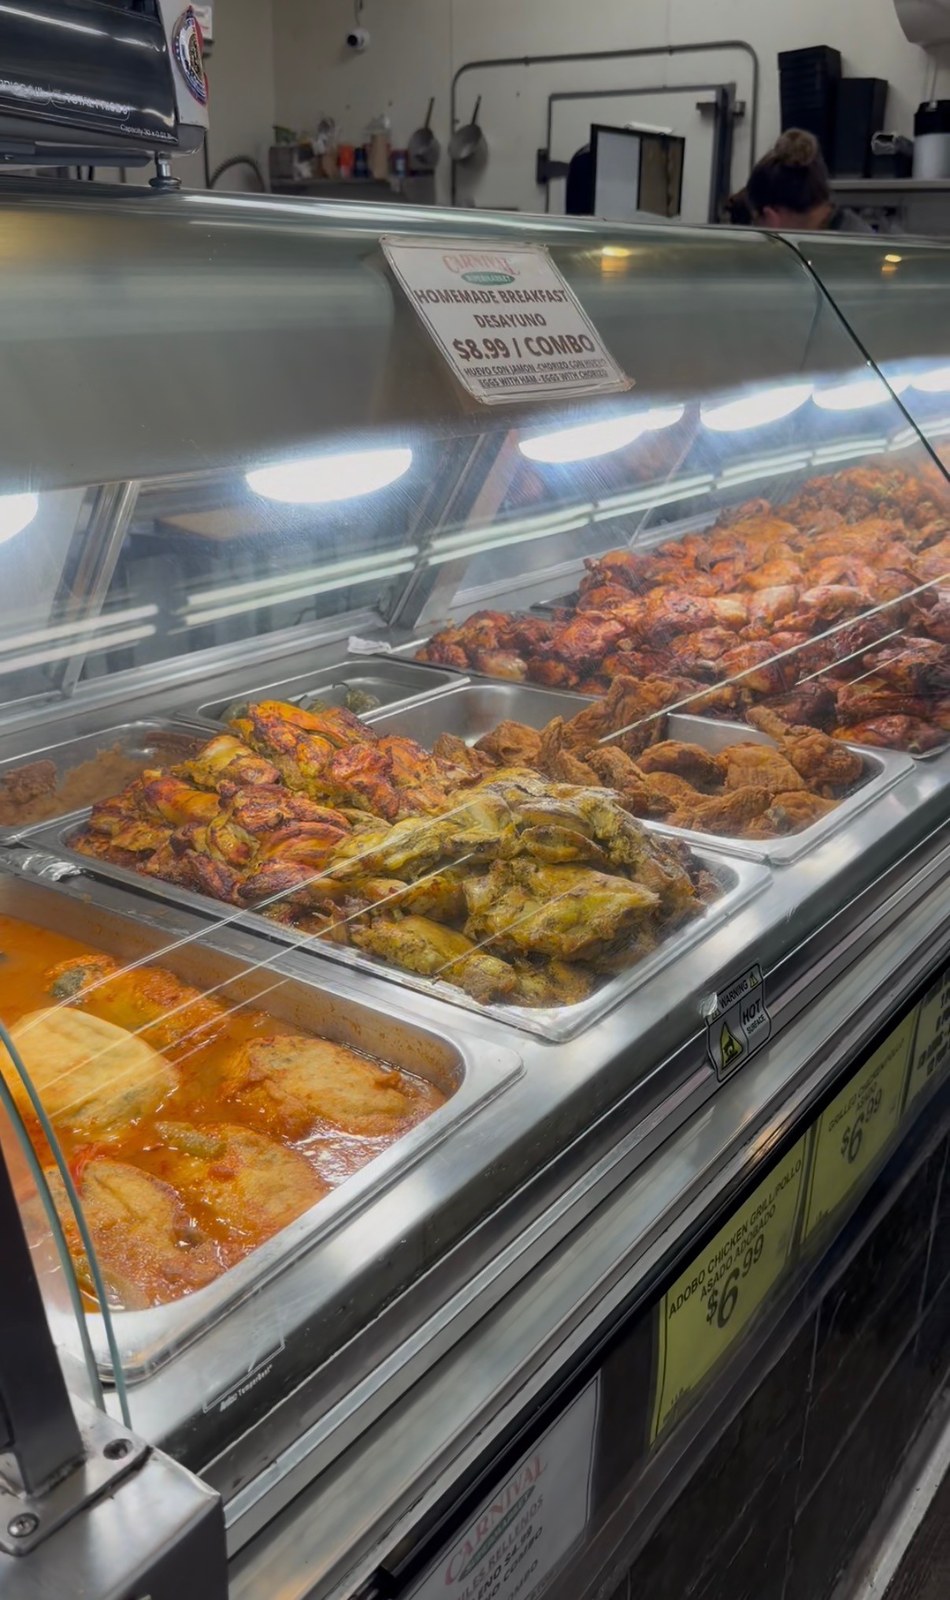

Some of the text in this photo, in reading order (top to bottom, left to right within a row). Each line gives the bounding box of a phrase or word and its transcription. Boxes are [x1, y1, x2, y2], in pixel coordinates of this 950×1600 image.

[413, 289, 568, 304] HOMEMADE BREAKFAST
[473, 313, 547, 329] DESAYUNO
[452, 337, 510, 362] $8.99
[524, 334, 595, 357] COMBO
[463, 366, 492, 377] HUEVO
[491, 364, 510, 376] CON
[479, 377, 500, 389] EGGS
[499, 376, 520, 387] WITH
[519, 375, 538, 386] HAM
[559, 371, 579, 382] WITH
[720, 979, 749, 1008] WARNING
[742, 998, 761, 1025] HOT
[746, 1013, 766, 1034] SURFACE
[700, 1203, 776, 1302] ASADO ADOBADO
[668, 1269, 705, 1319] ADOBO
[707, 1221, 748, 1274] CHICKEN
[444, 1454, 549, 1586] CARNIVAL
[488, 1492, 544, 1572] RELLENOS
[502, 1525, 543, 1582] COMBO
